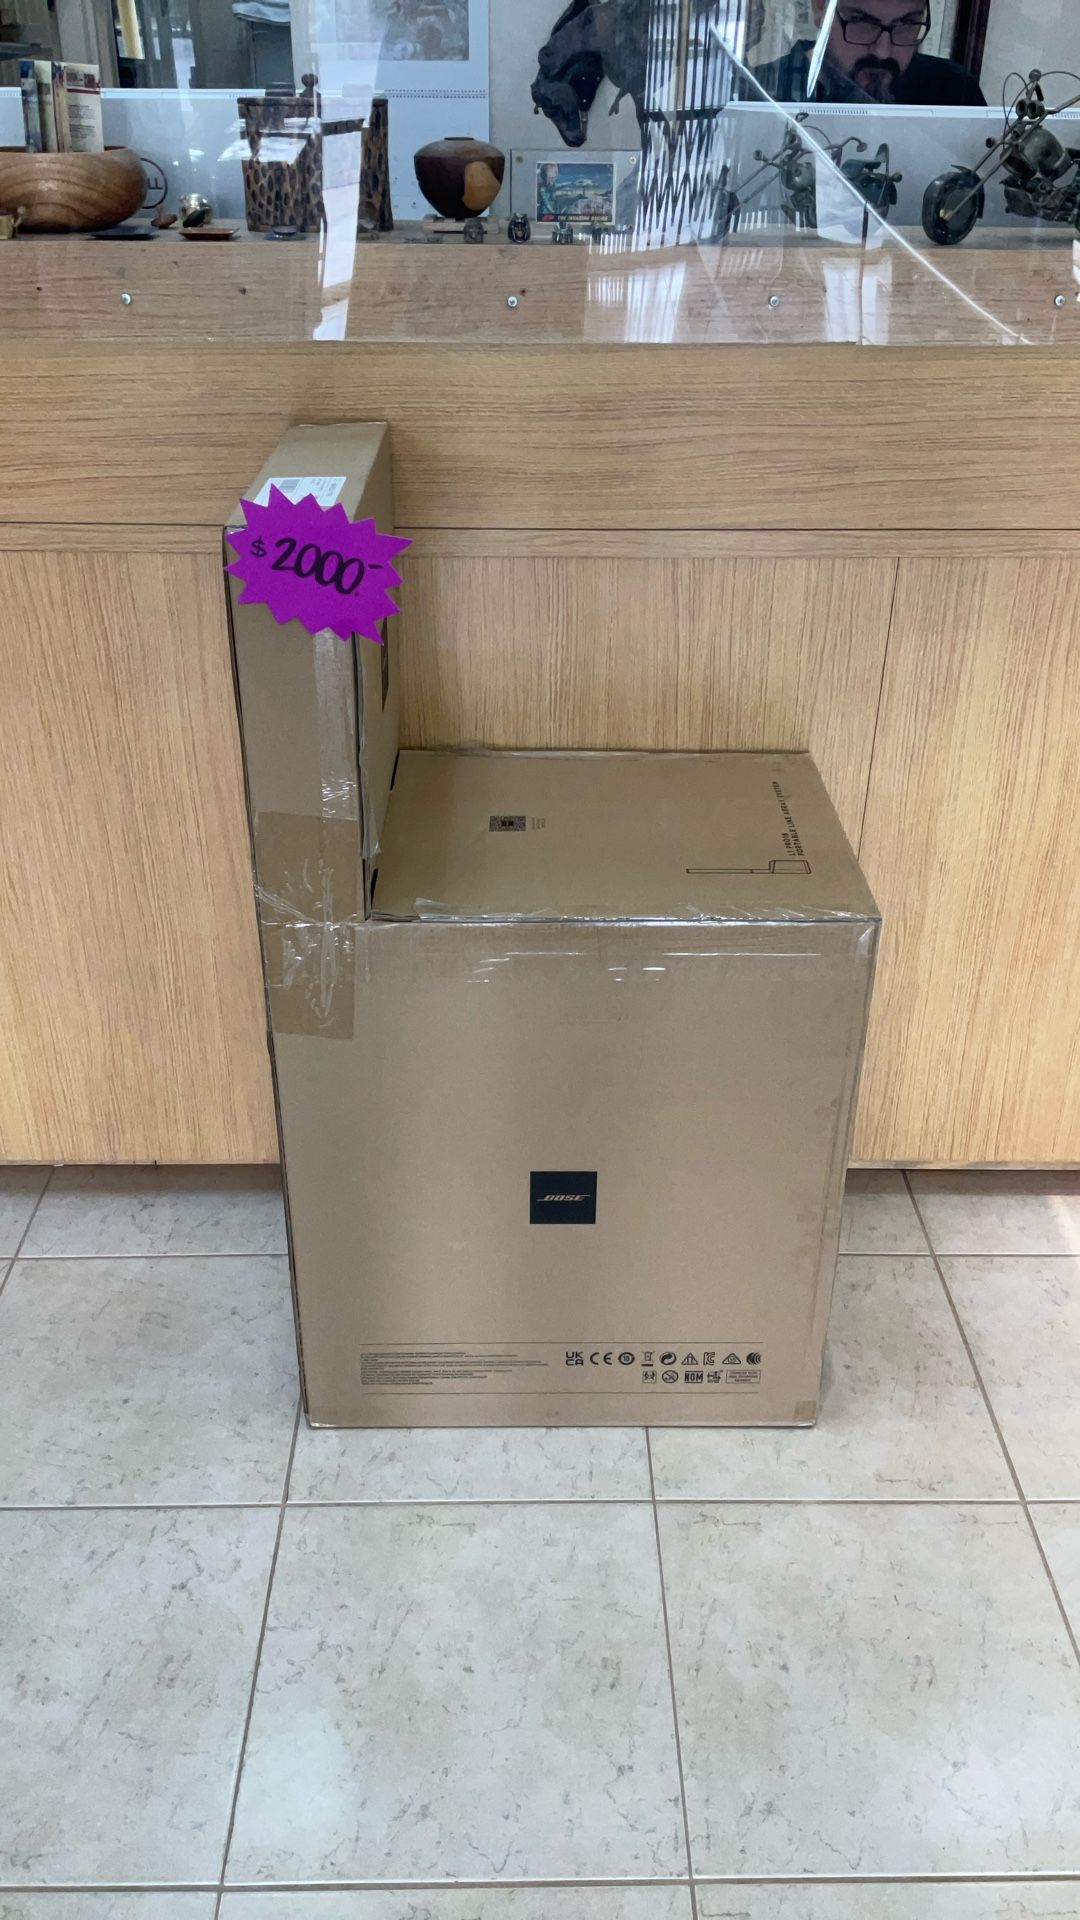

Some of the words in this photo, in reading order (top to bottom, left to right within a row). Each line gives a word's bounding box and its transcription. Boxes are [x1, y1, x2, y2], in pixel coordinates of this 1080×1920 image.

[784, 816, 795, 828] LINE
[788, 828, 805, 856] PORTABLE
[538, 1194, 590, 1202] BOSE
[684, 1371, 704, 1384] NOM
